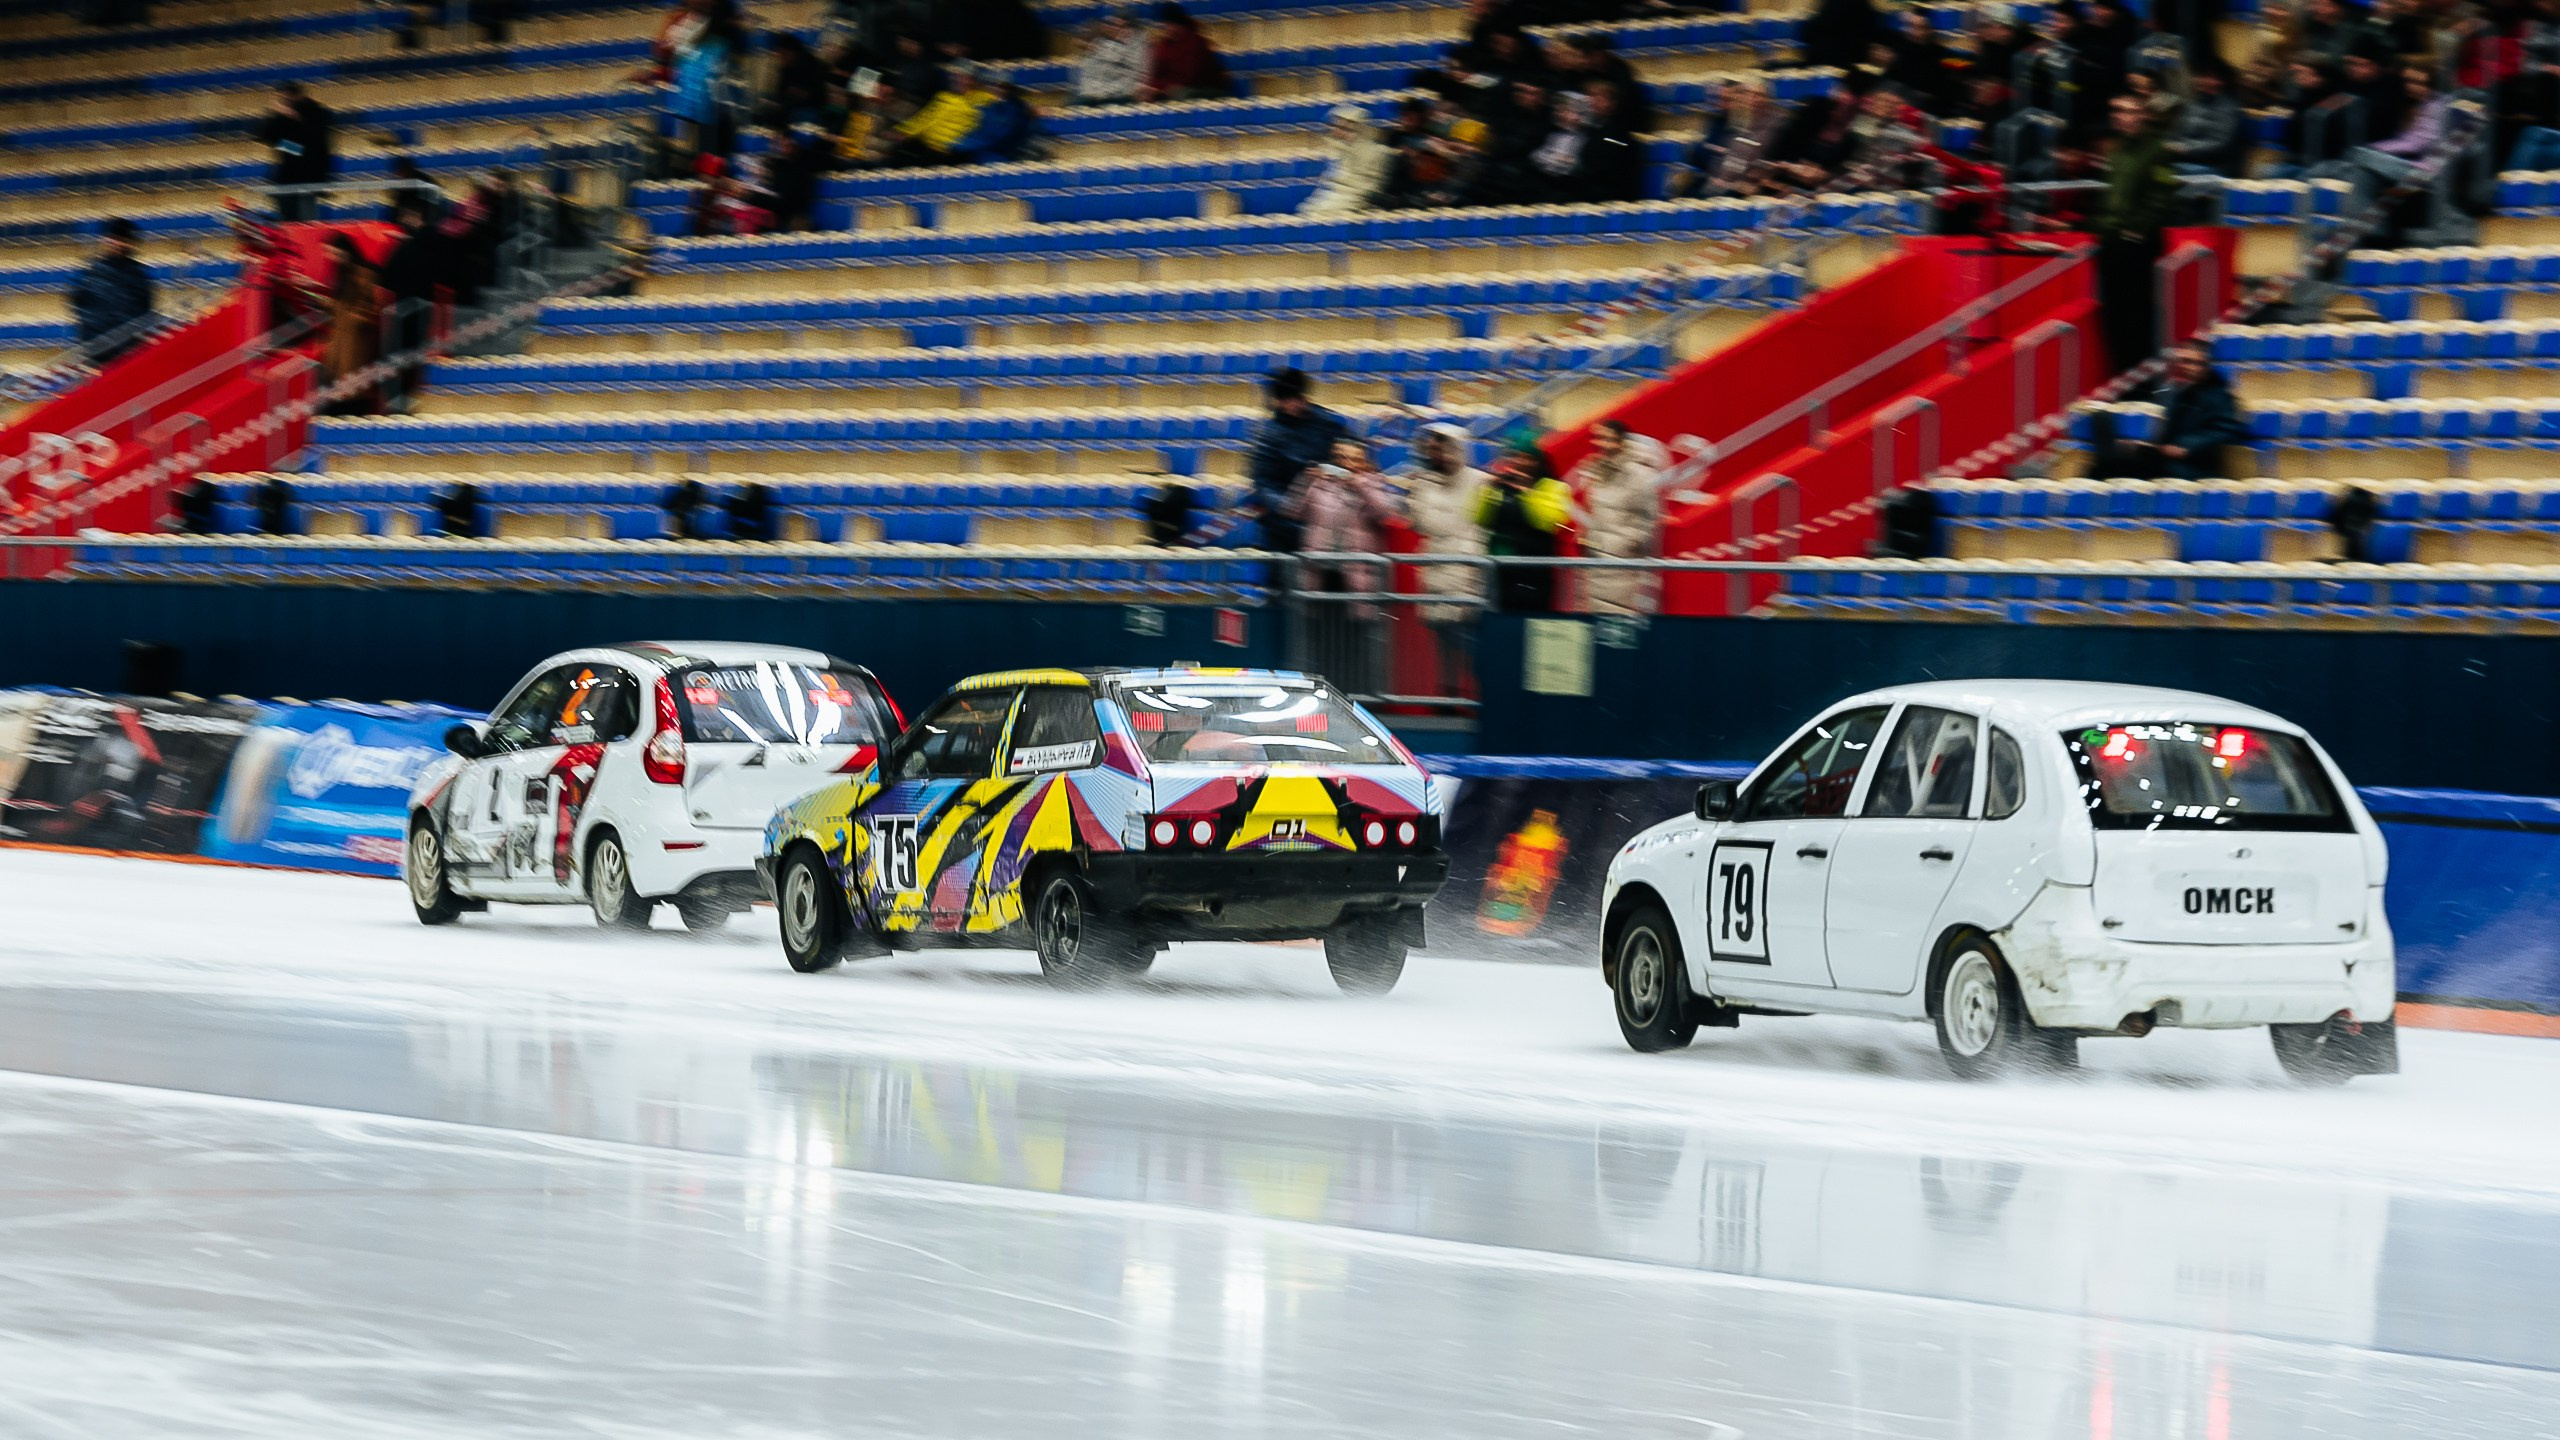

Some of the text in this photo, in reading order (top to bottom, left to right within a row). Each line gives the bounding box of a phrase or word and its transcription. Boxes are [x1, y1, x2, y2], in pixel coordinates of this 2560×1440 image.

[877, 818, 917, 889] 75
[1719, 861, 1755, 942] 79
[2184, 886, 2275, 915] ОМСК
